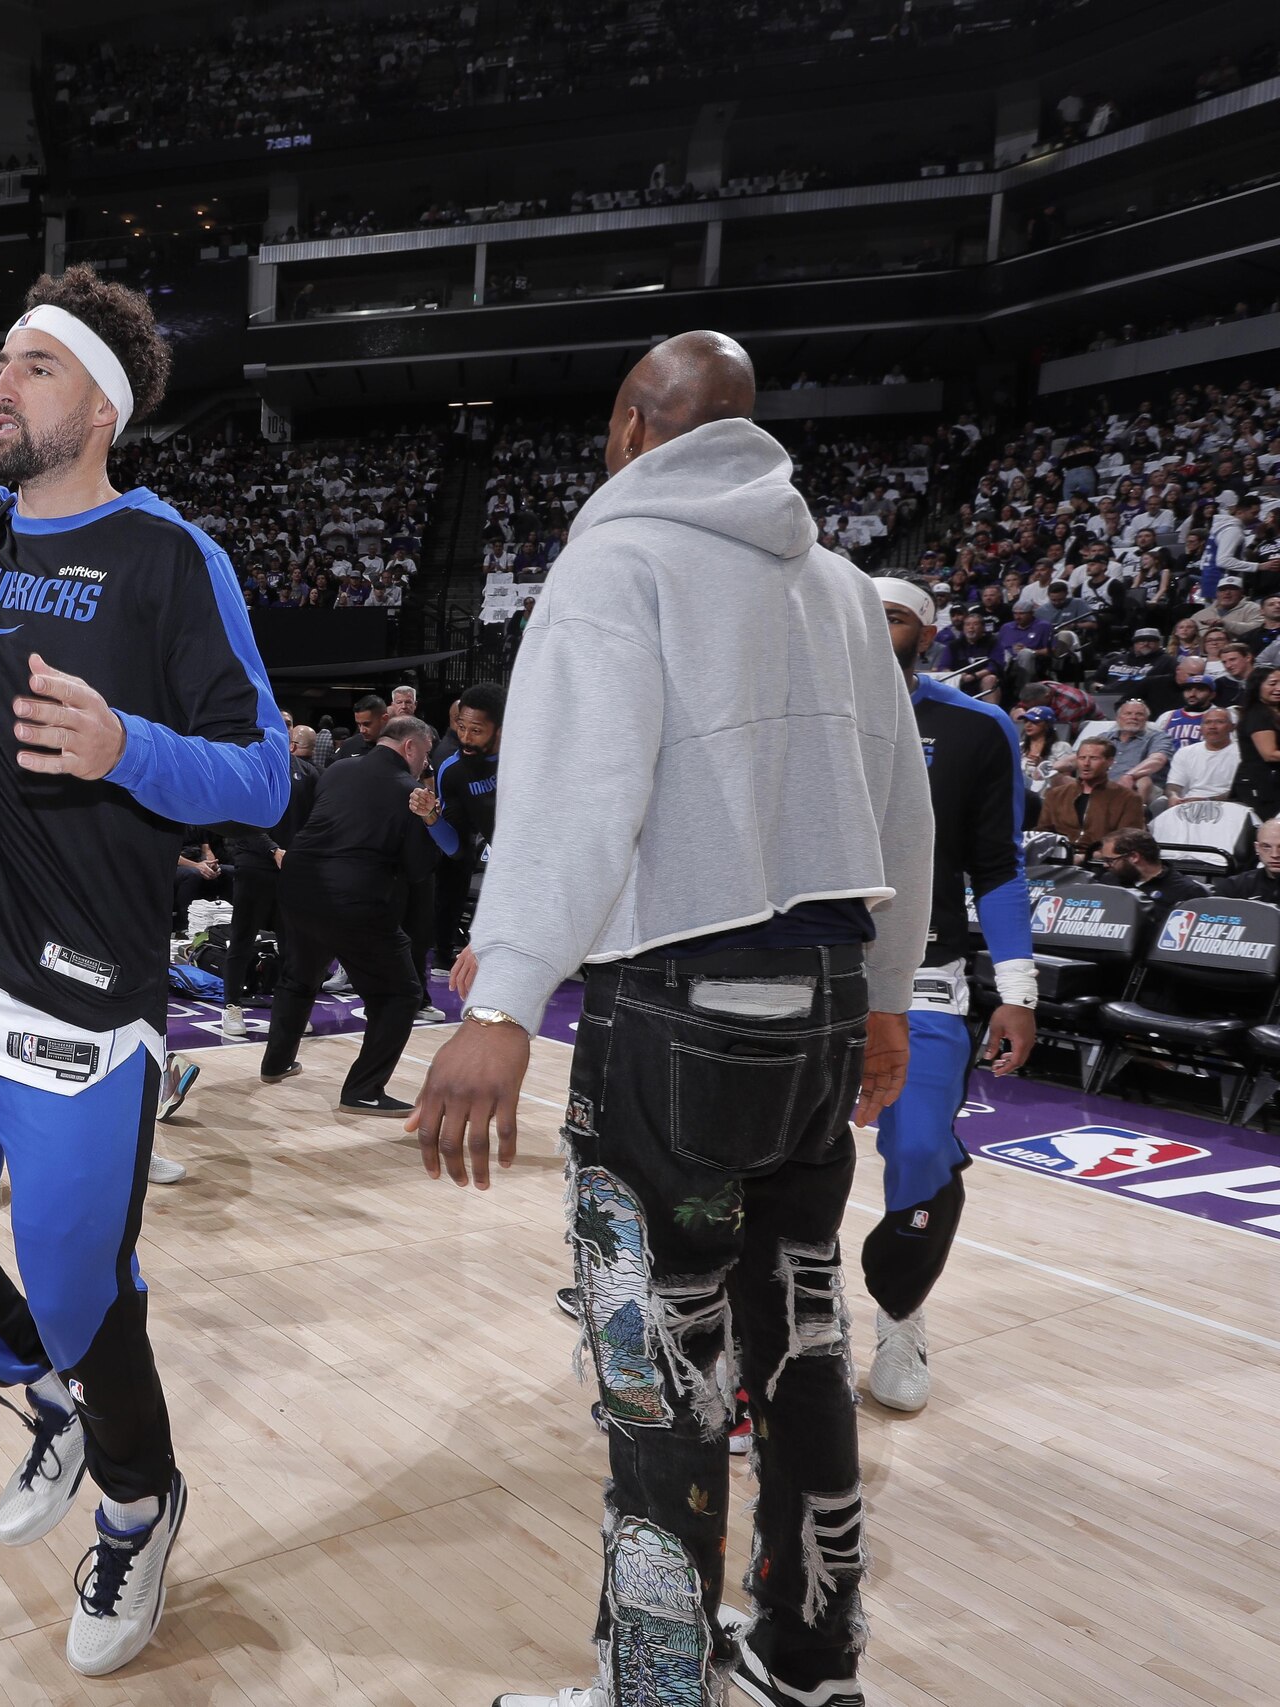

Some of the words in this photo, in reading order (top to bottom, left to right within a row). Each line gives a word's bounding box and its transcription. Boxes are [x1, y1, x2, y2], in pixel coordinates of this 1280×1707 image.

[58, 565, 108, 582] shiftkey
[1064, 898, 1090, 908] SoFi
[1058, 906, 1106, 923] PLAY-IN
[1199, 913, 1228, 923] SoFi
[1053, 920, 1132, 939] TOURNAMENT
[1191, 921, 1247, 940] PLAY-IN
[61, 951, 69, 960] XL
[1186, 936, 1276, 959] TOURNAMENT
[997, 1147, 1066, 1168] NBA
